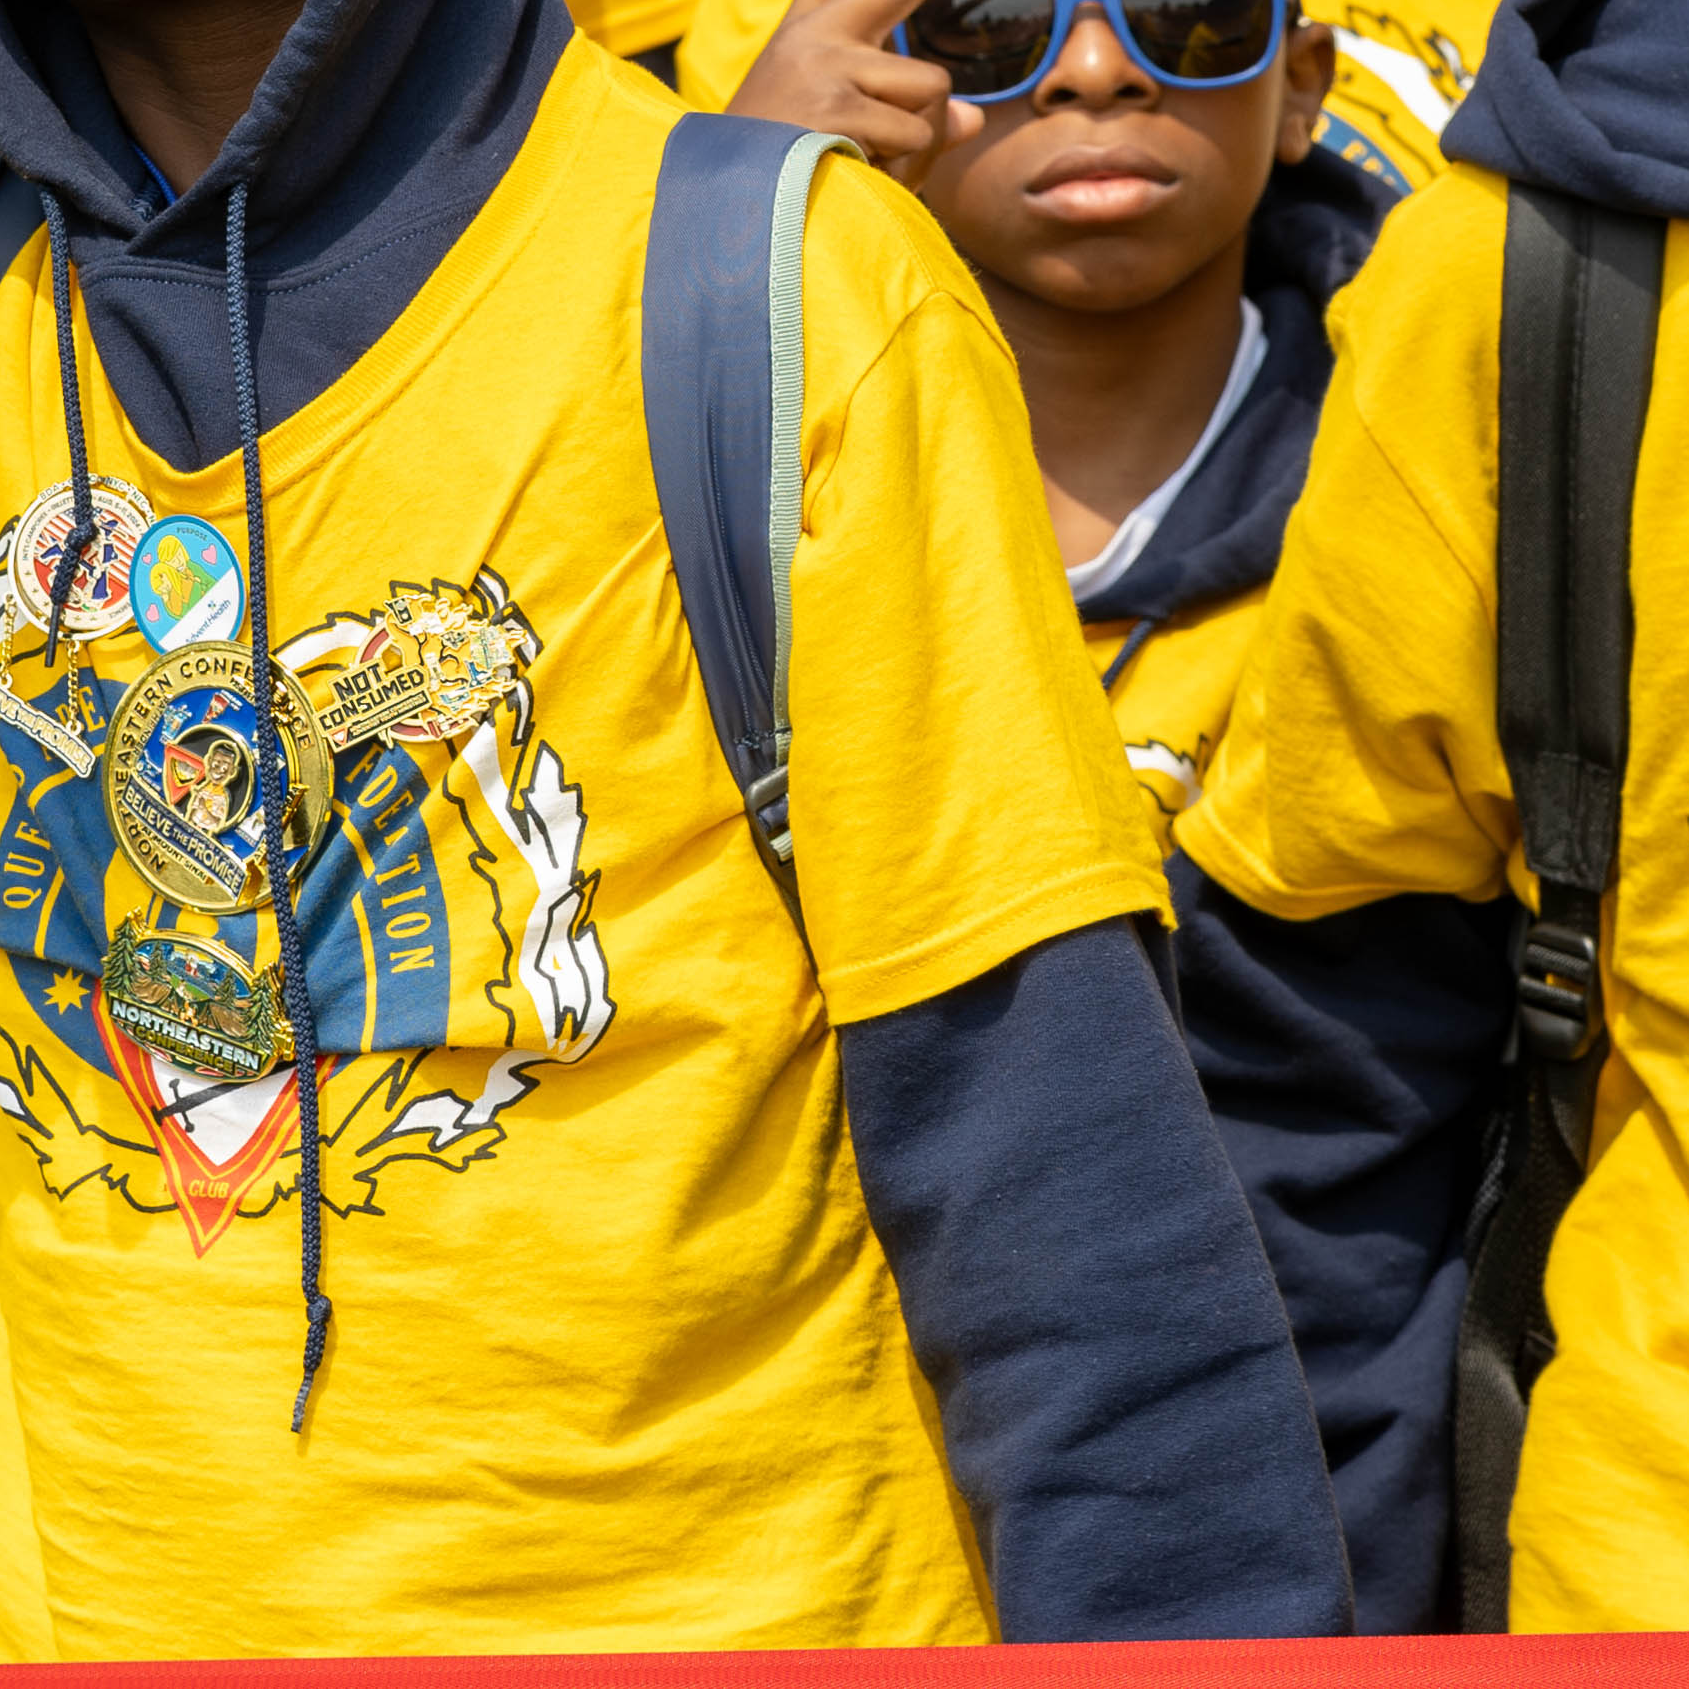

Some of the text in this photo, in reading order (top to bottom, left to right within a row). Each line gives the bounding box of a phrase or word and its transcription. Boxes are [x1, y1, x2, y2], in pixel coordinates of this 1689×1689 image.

[317, 668, 425, 732] CONSUMED
[332, 662, 385, 704] NOT
[31, 715, 93, 773] PROMISE
[125, 786, 243, 893] BELIEVE THE PROMISE
[152, 834, 185, 863] MOUNT
[184, 858, 209, 883] SINAI
[111, 999, 261, 1072] NORTHEASTERN
[134, 1025, 235, 1075] CONFERENCE
[187, 1178, 231, 1200] CLUB
